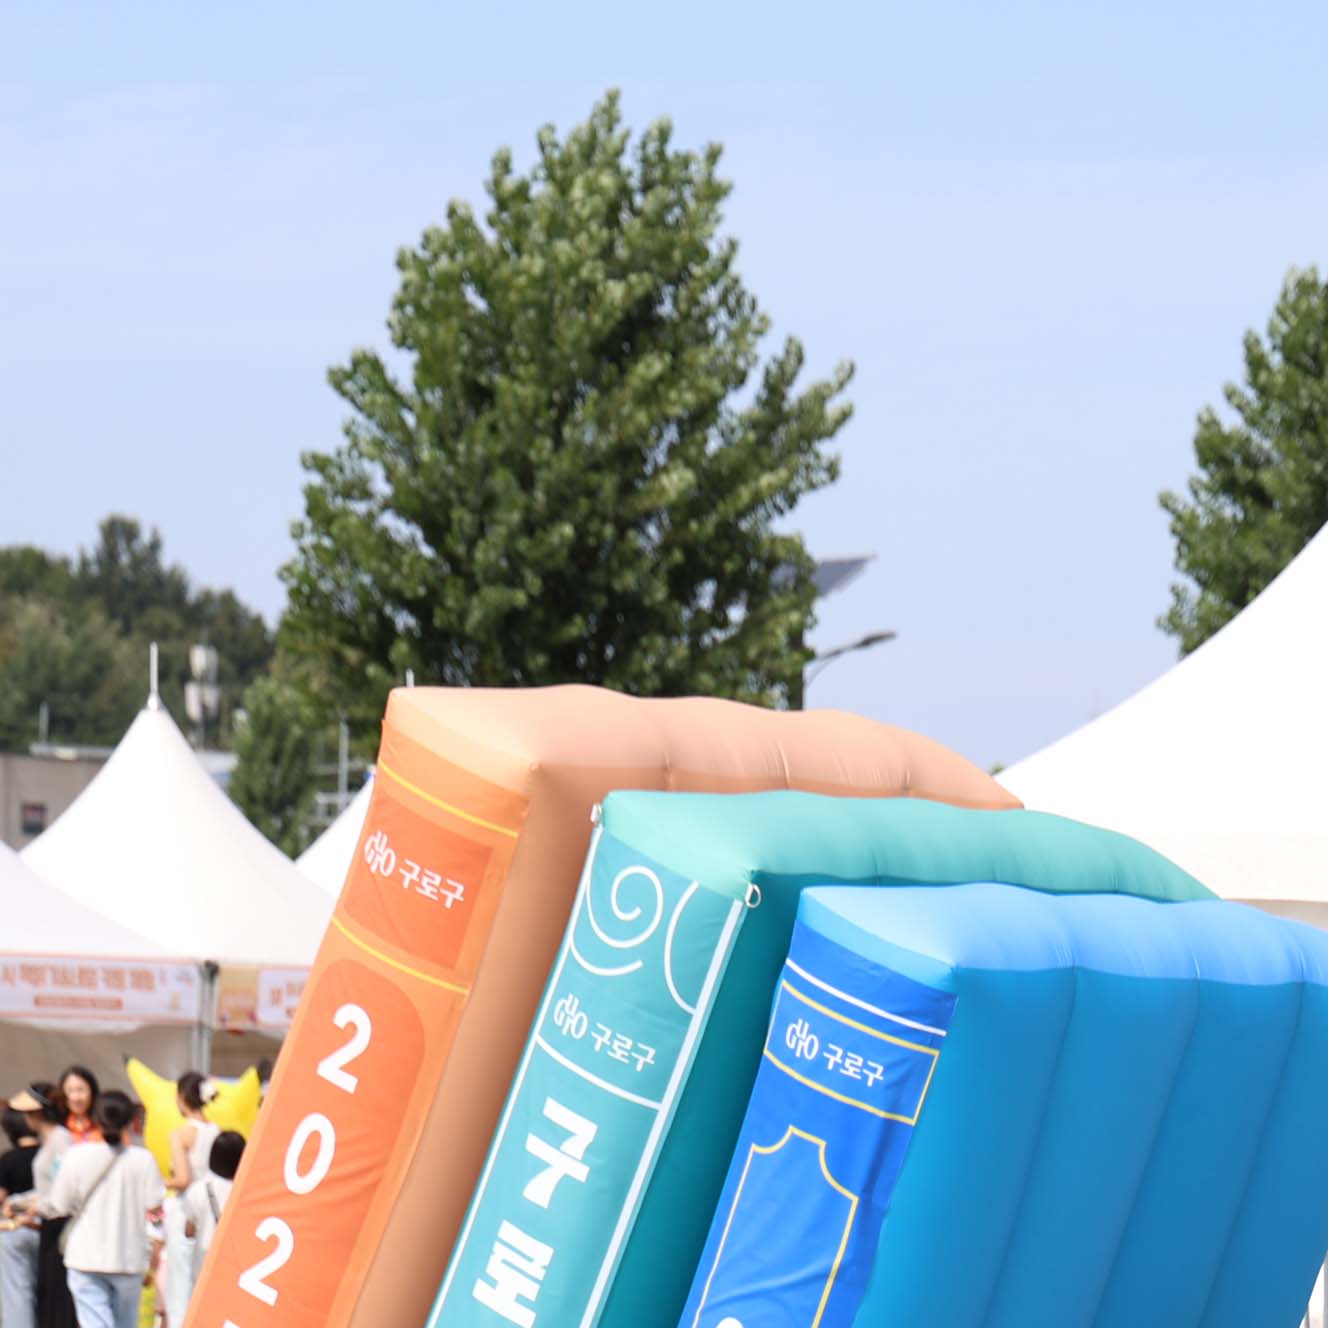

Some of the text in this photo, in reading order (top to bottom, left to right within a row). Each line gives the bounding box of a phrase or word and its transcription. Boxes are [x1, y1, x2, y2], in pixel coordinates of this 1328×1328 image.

[399, 858, 465, 909] 구로구
[591, 1022, 656, 1072] 구로구
[823, 1043, 884, 1087] 구로구
